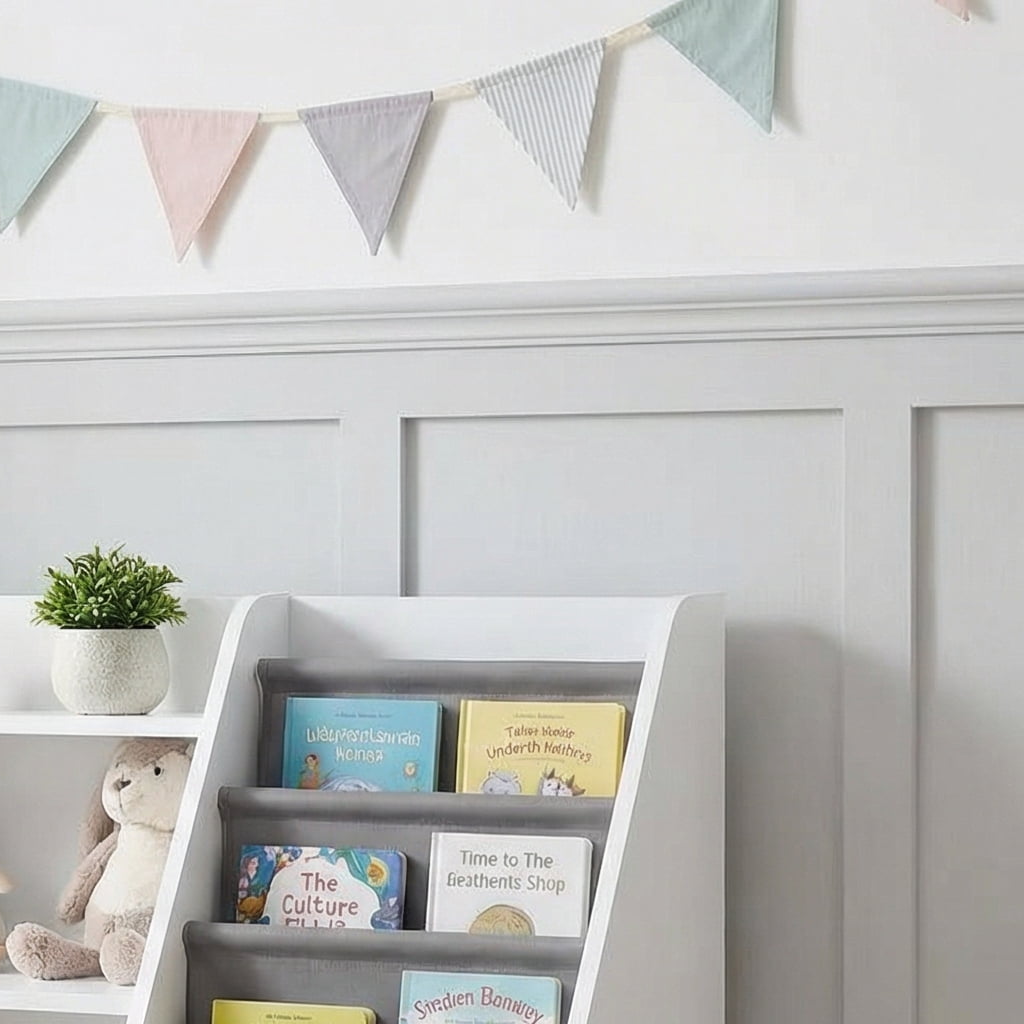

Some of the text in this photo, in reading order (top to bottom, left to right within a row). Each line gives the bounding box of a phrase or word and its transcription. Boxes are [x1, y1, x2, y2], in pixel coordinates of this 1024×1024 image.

[460, 850, 554, 869] Time to The
[300, 871, 338, 892] The
[526, 874, 565, 895] Shop
[282, 894, 359, 917] Culture
